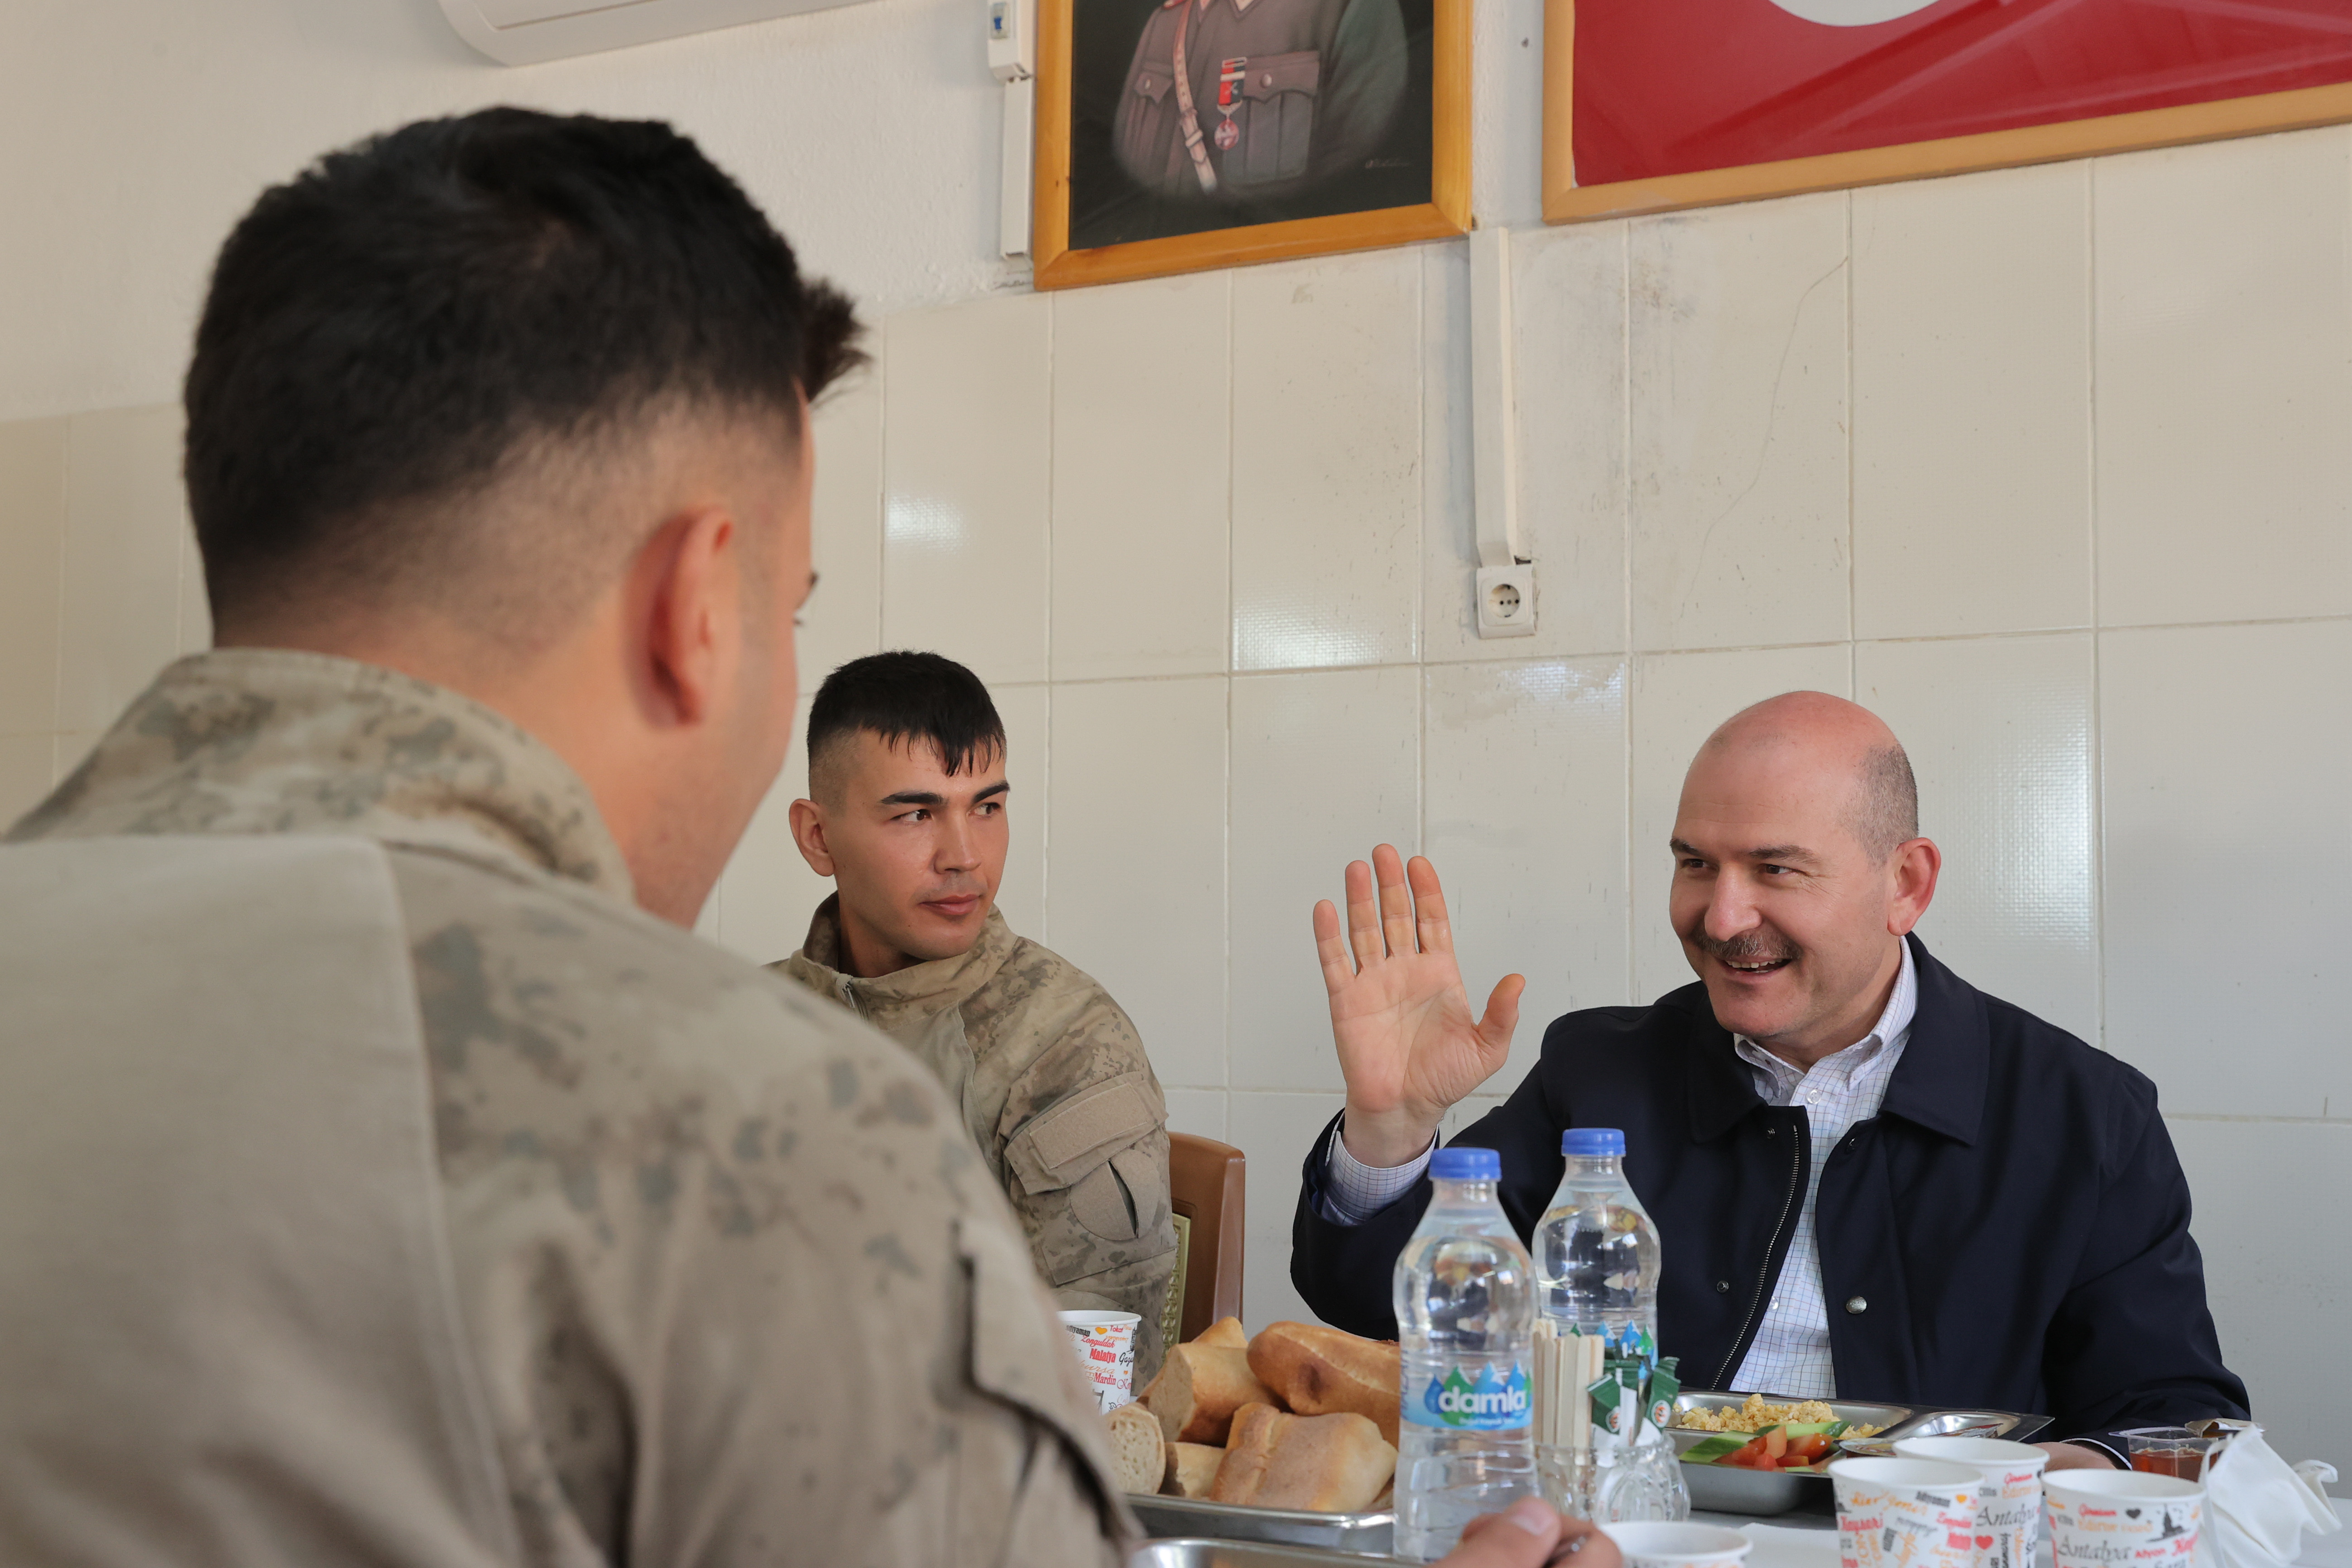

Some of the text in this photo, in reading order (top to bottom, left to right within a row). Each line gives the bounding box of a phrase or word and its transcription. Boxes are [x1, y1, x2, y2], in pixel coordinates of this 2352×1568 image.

[1080, 1335, 1115, 1348] Zonguldak
[1090, 1348, 1116, 1363] Malatya
[1094, 1372, 1116, 1385] Mardin
[1438, 1385, 1526, 1413] damla
